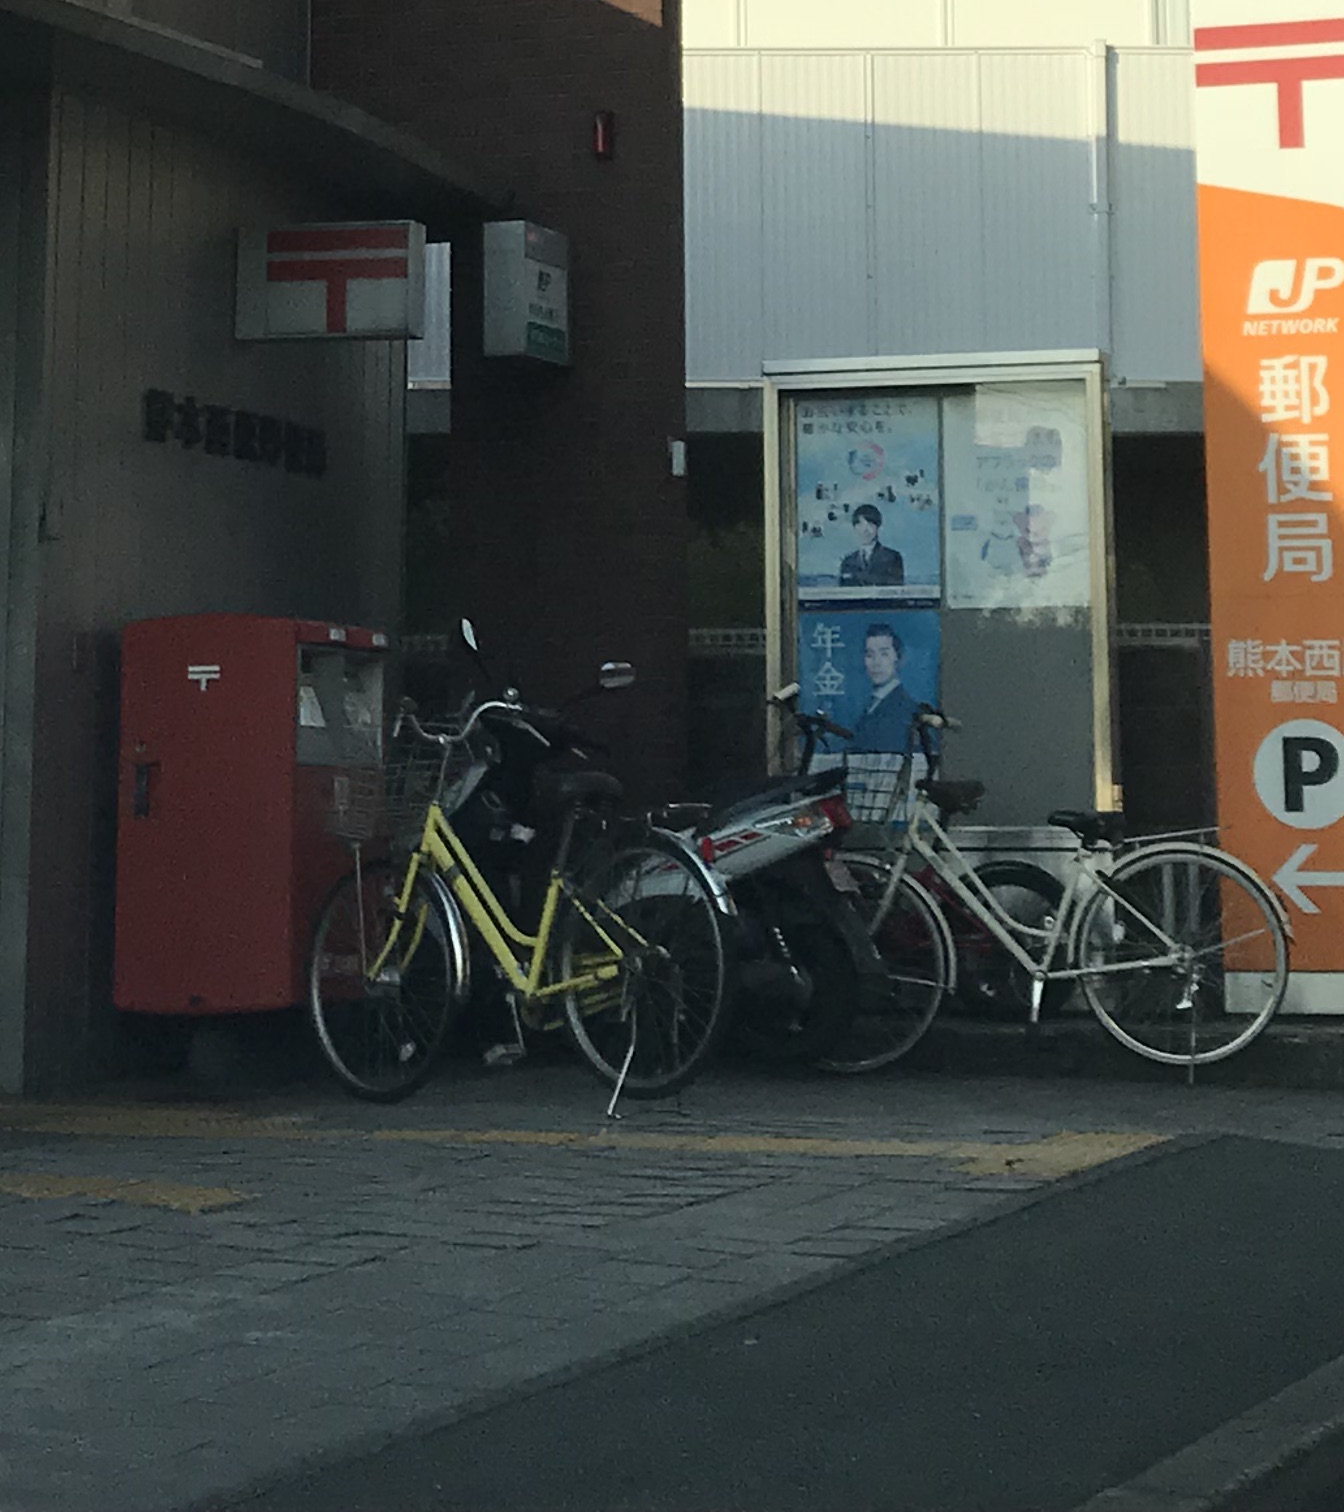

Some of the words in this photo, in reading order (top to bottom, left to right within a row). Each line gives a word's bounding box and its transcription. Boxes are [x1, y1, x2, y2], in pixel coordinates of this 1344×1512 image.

[1241, 316, 1340, 337] NETWORK
[1257, 353, 1334, 583] 郵便局
[810, 621, 846, 697] 年金
[1281, 735, 1340, 813] P
